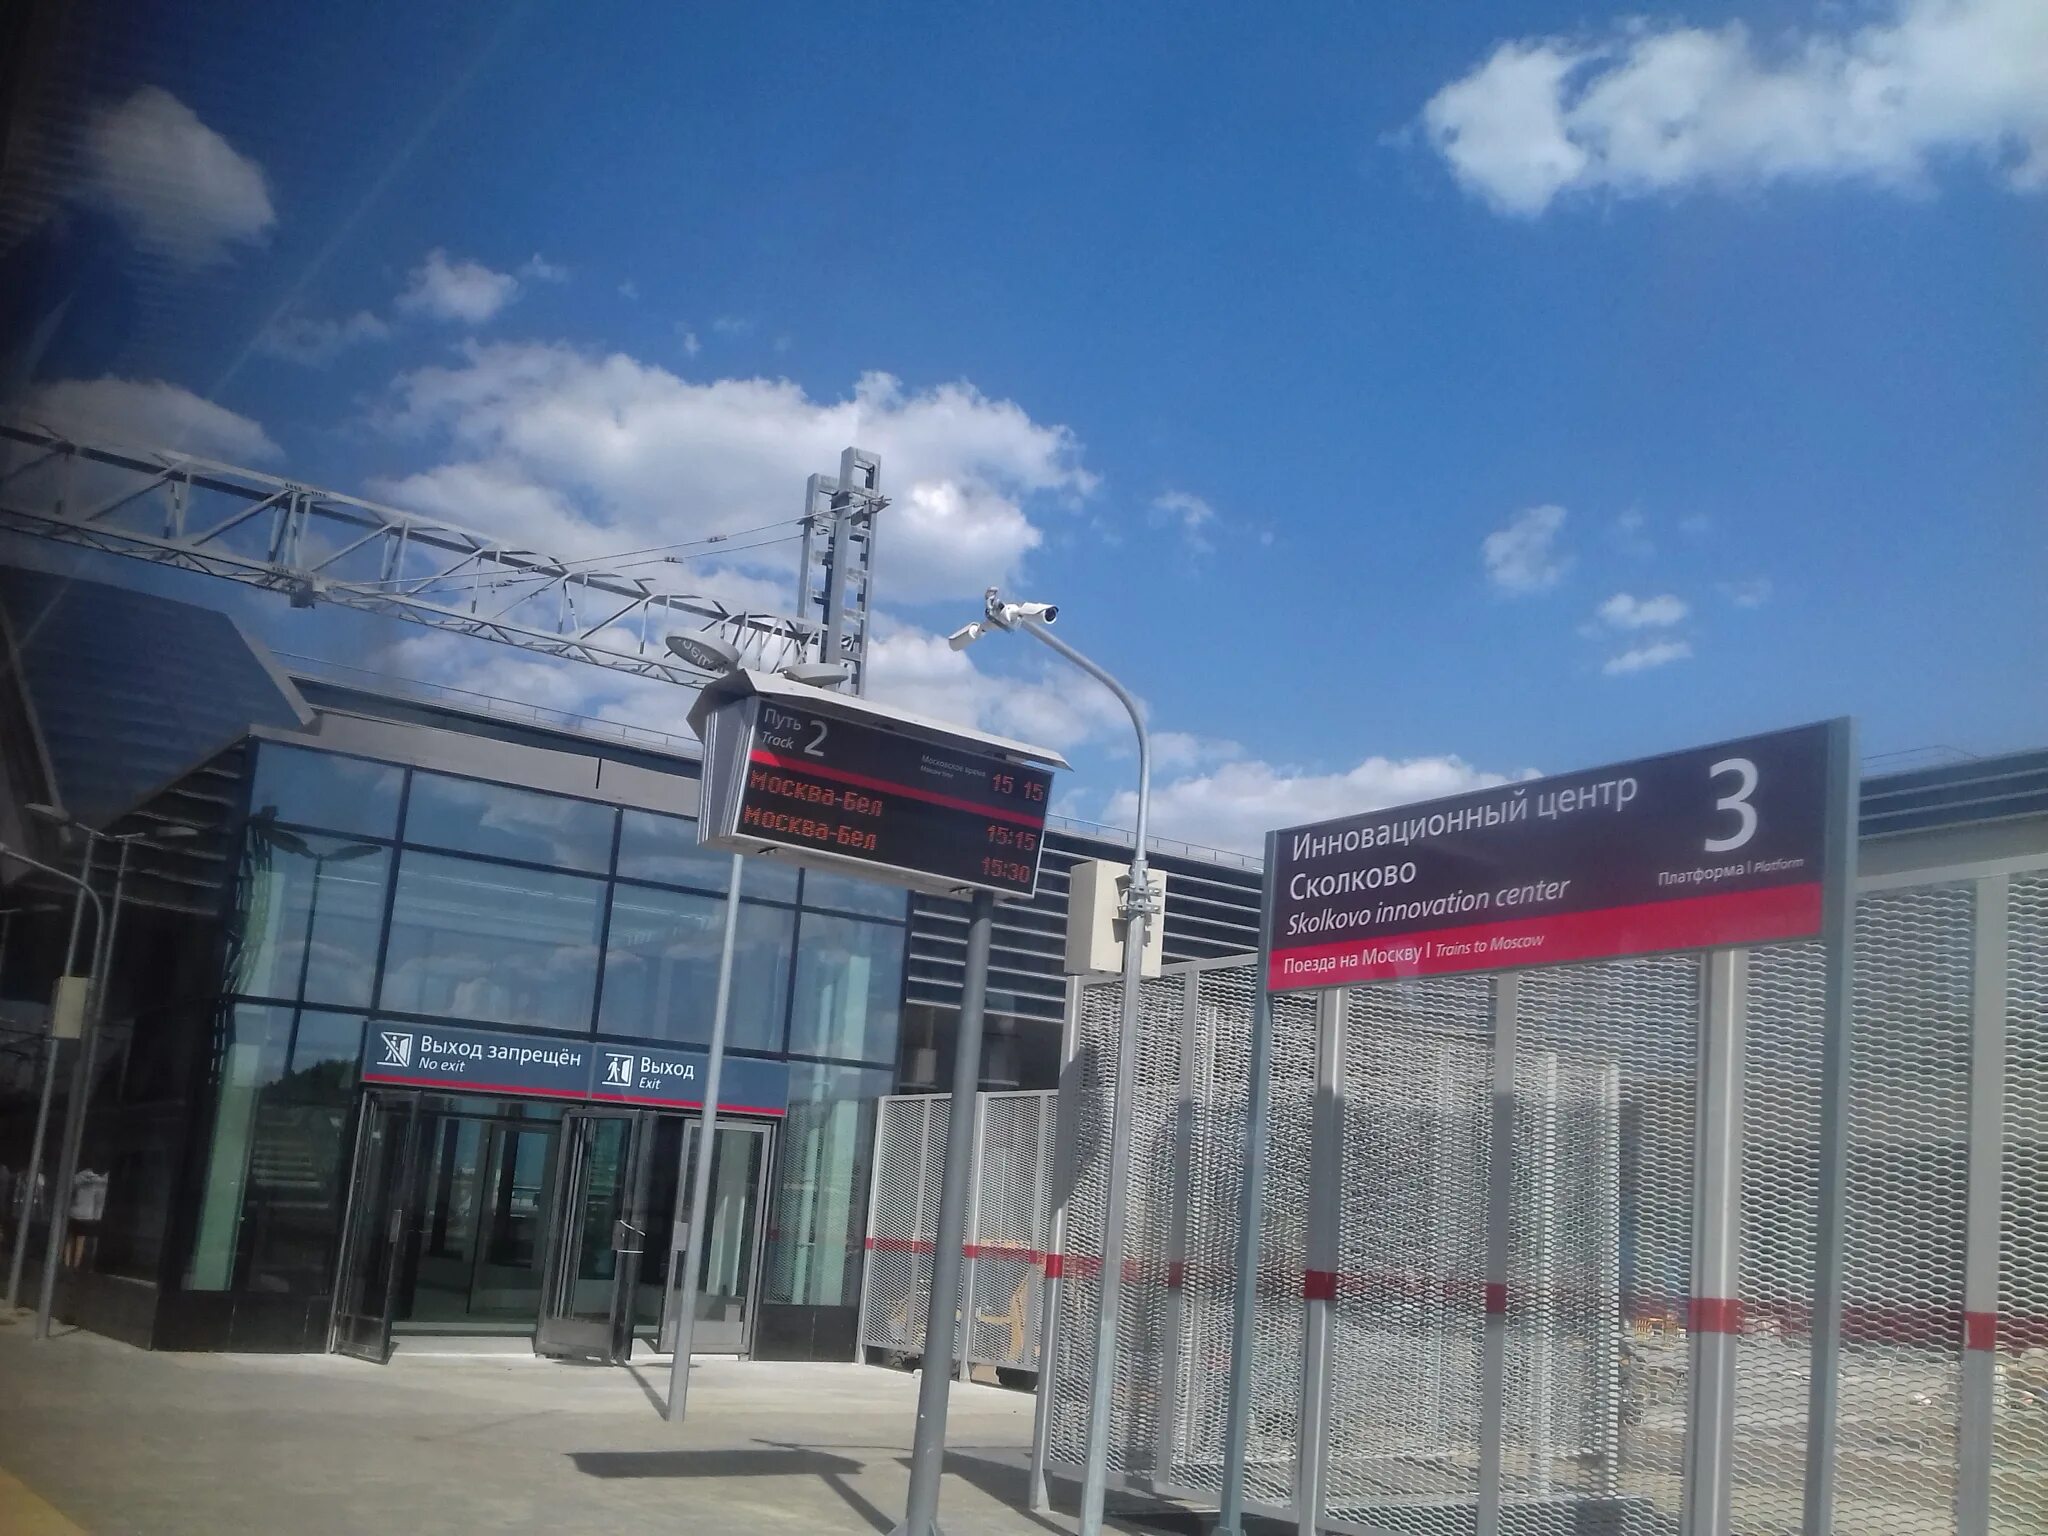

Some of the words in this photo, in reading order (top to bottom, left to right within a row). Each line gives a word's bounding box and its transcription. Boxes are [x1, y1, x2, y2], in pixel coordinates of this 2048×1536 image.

[764, 708, 802, 731] Путь
[762, 731, 795, 750] Track
[804, 719, 828, 757] 2
[750, 769, 883, 817] Москва-Бел
[992, 773, 1015, 794] 15
[1024, 781, 1044, 801] 15
[1704, 757, 1759, 852] 3
[744, 804, 877, 850] Москва-Бел
[1292, 788, 1528, 862] Инновационный
[1538, 777, 1638, 820] центр
[987, 825, 1037, 851] 15:15
[982, 857, 1031, 883] 15:30
[1658, 863, 1745, 886] Платформа
[1753, 857, 1805, 873] Platform
[1289, 861, 1417, 901] Сколково
[1286, 907, 1371, 936] Skolkovo
[1375, 889, 1490, 924] innovation
[1496, 880, 1572, 907] center
[1436, 943, 1471, 957] Trains
[1474, 940, 1487, 953] to
[1490, 934, 1545, 952] Moscow
[1284, 956, 1337, 975] Поезда
[1340, 953, 1358, 968] на
[1362, 945, 1423, 966] Москву
[418, 1056, 438, 1070] No
[440, 1060, 466, 1073] exit
[420, 1035, 483, 1061] Выход
[487, 1045, 582, 1068] запрещён
[640, 1056, 695, 1080] Выход
[639, 1077, 662, 1090] Exit
